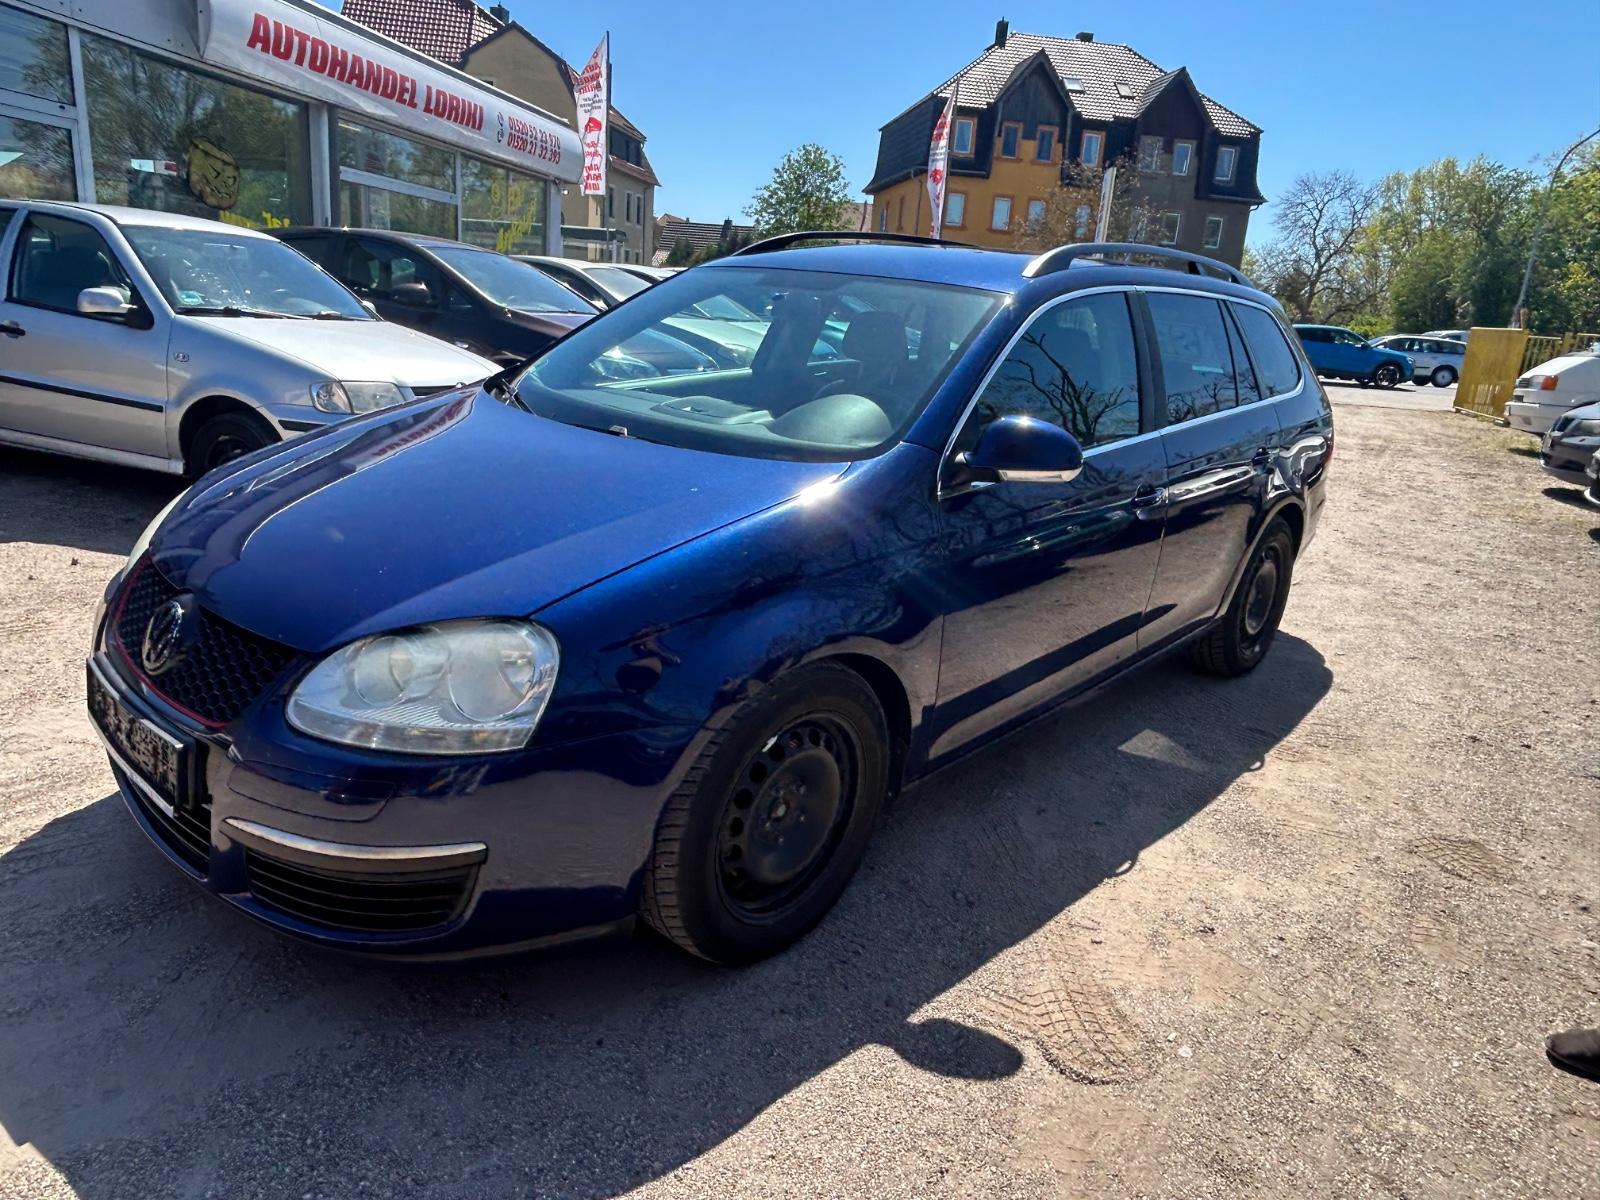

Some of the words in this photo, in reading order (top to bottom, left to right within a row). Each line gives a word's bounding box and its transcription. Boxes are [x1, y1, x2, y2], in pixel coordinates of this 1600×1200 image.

[247, 12, 418, 109] AUTOHANDEL
[507, 132, 528, 152] 01520
[528, 141, 537, 156] 21
[538, 144, 548, 160] 32
[548, 148, 561, 165] 393
